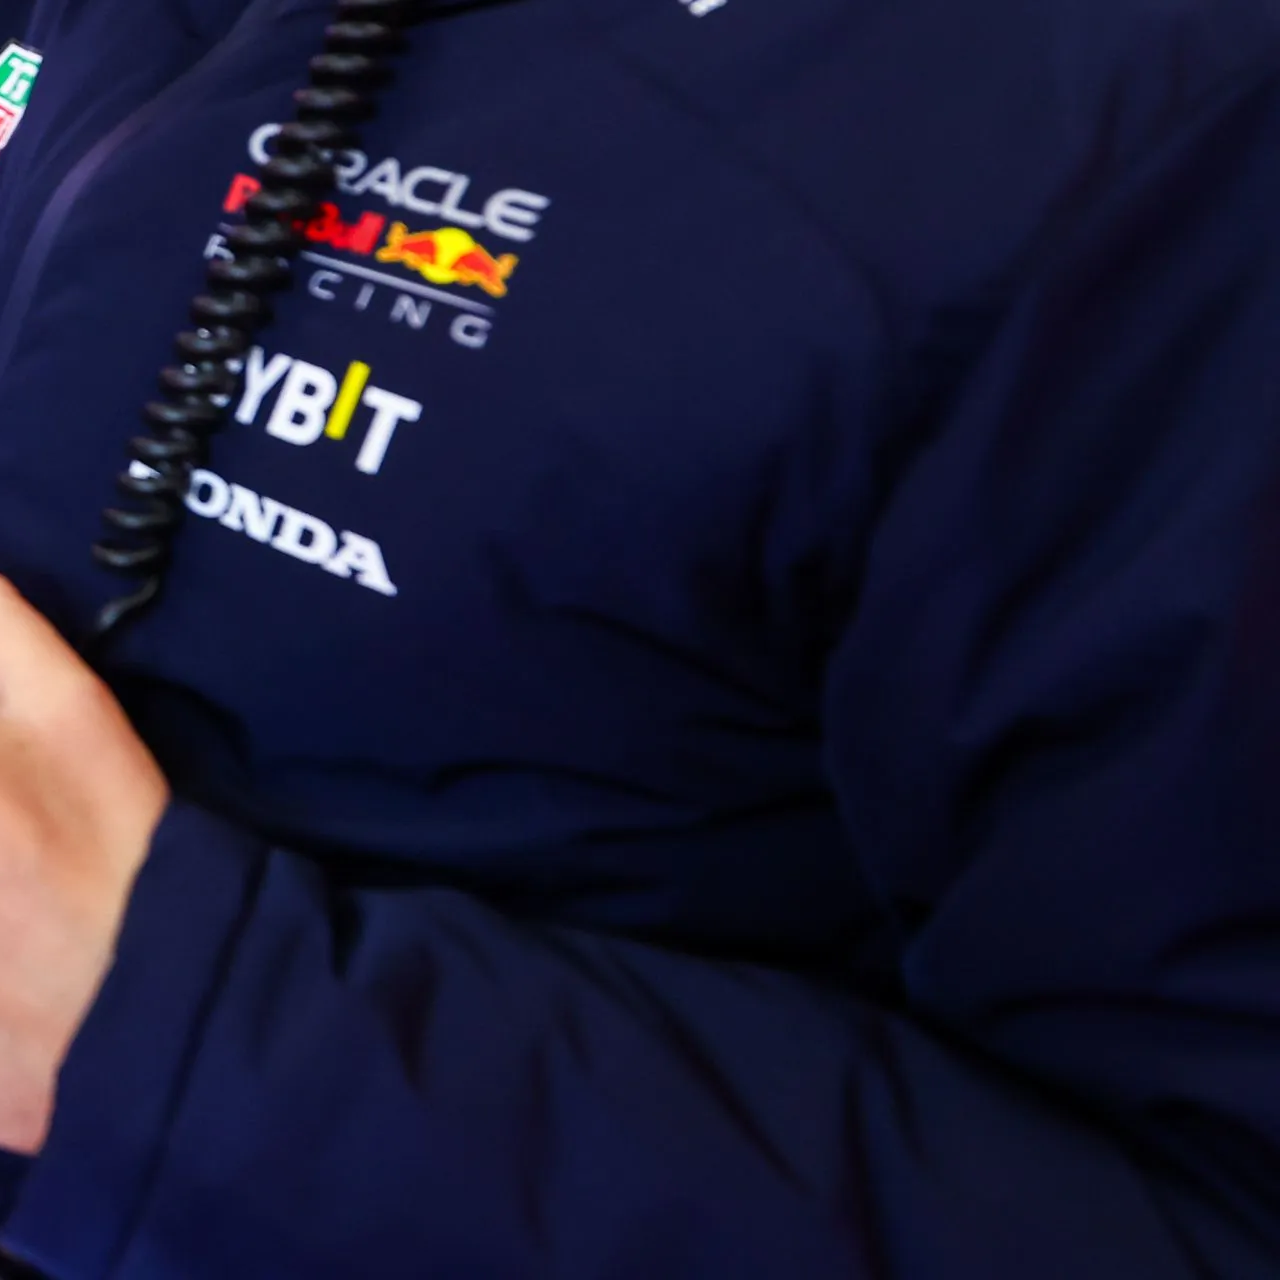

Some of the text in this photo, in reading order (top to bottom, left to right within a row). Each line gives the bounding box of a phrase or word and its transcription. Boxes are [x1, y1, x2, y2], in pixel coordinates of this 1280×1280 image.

[203, 232, 494, 348] RCING
[209, 344, 423, 476] YBIT
[129, 460, 398, 597] ONDA
